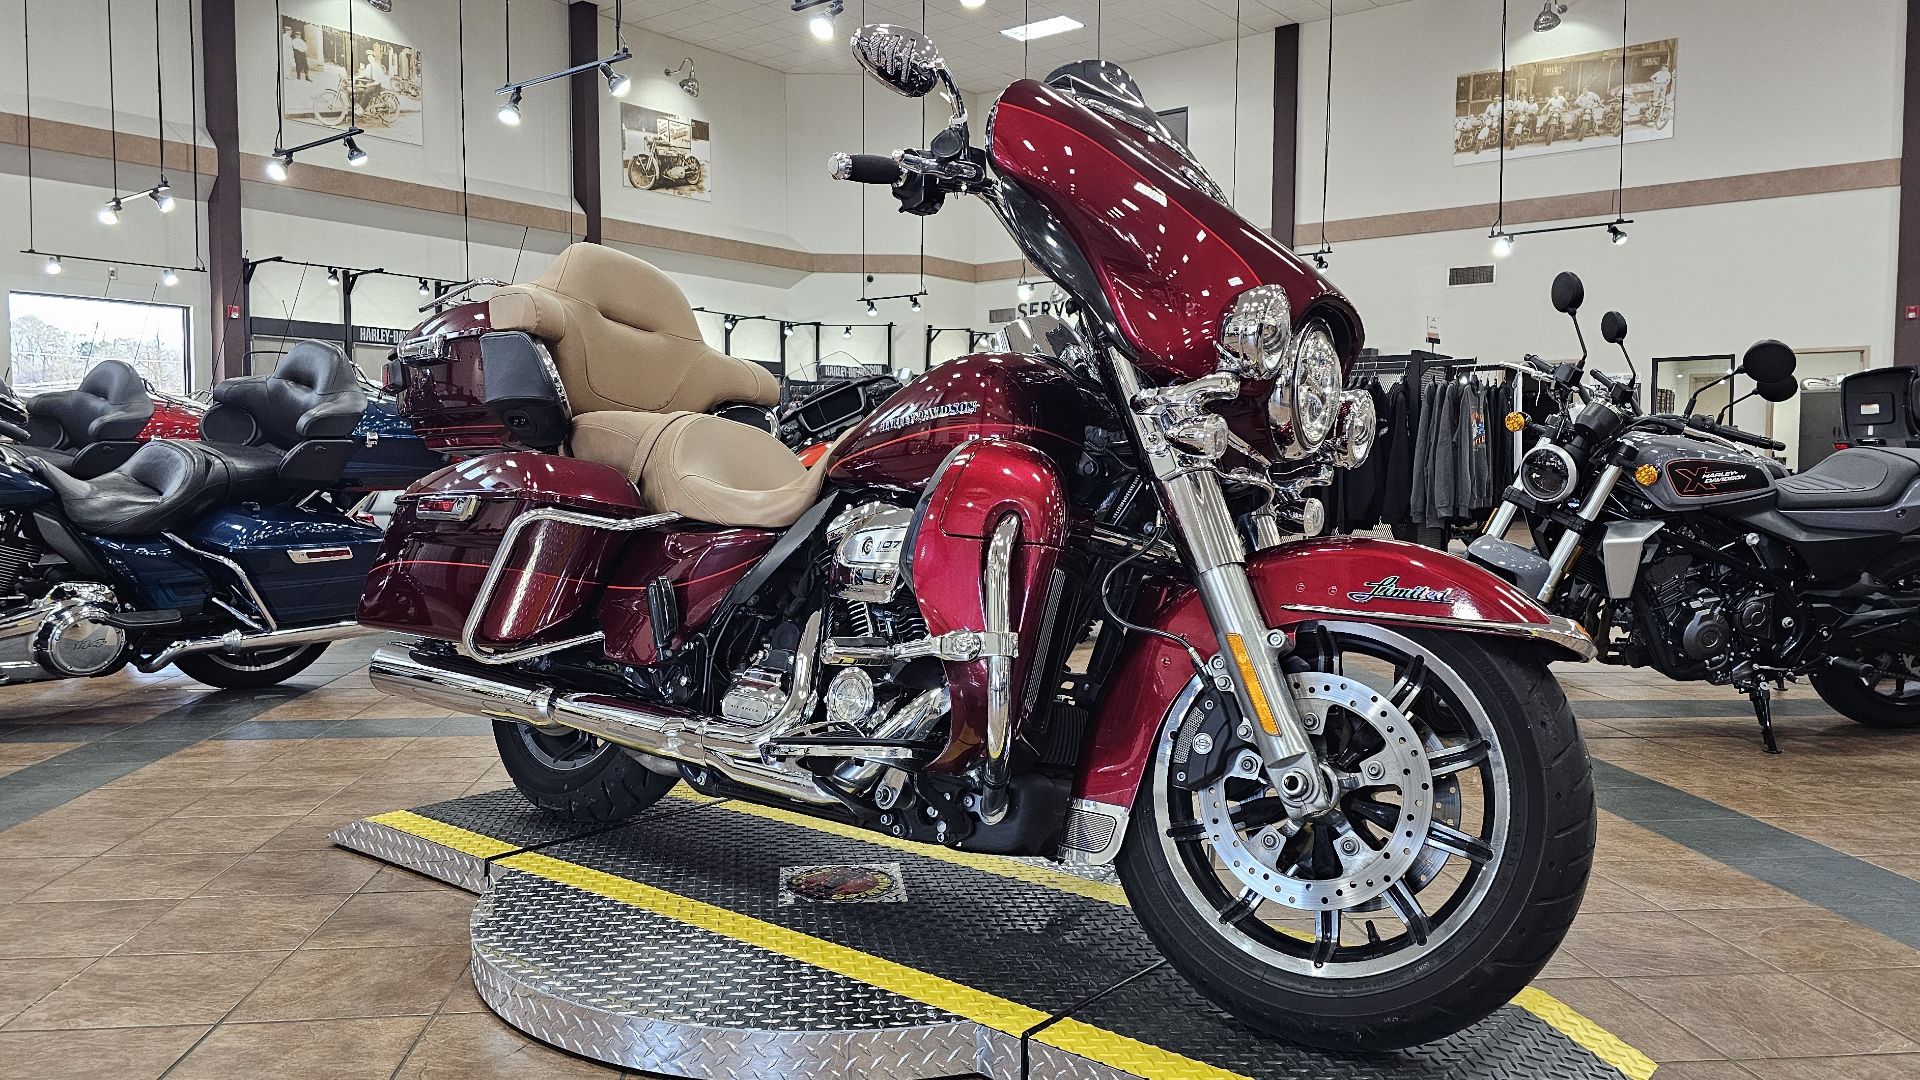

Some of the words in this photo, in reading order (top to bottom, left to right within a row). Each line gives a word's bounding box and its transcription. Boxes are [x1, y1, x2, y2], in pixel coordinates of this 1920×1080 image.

[1703, 473, 1747, 484] DAVIDSON
[877, 540, 902, 550] 107
[1347, 576, 1455, 603] Limited
